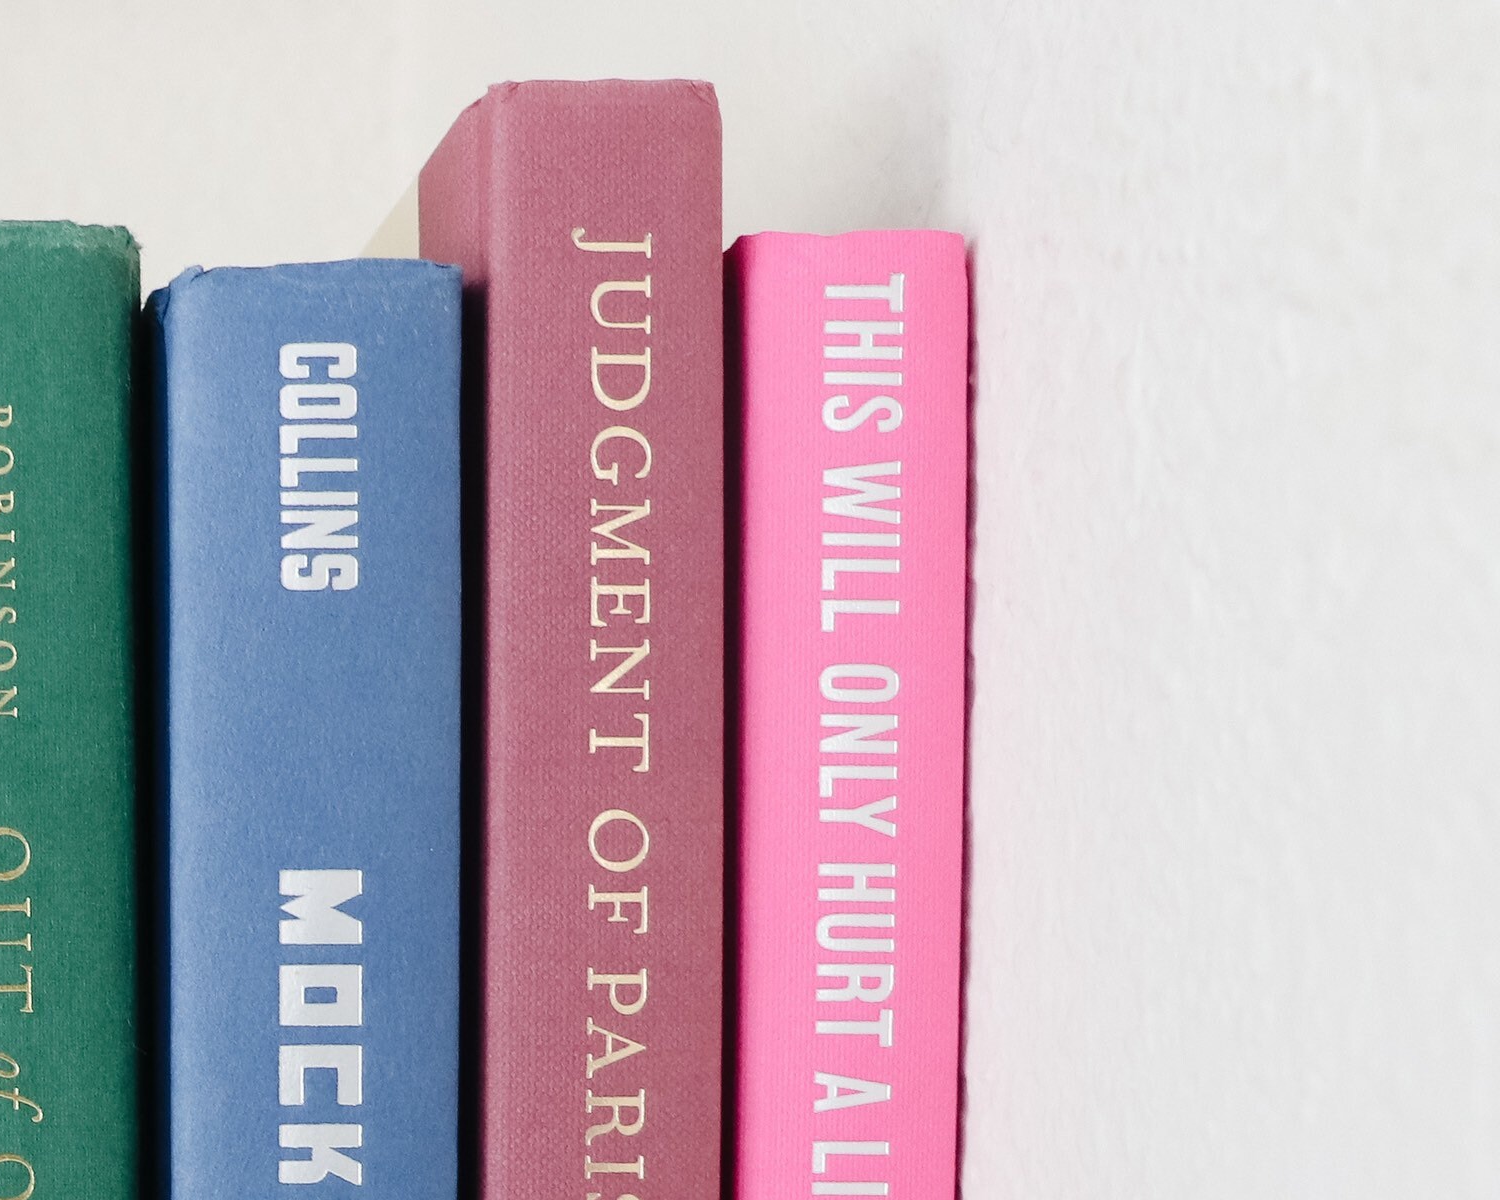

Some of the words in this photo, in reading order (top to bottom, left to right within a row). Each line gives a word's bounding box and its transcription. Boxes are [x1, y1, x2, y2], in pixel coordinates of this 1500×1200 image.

[821, 272, 905, 433] THIS
[278, 341, 359, 592] COLLINS
[571, 226, 652, 774] JUDGMENT
[821, 460, 902, 633] WILL
[818, 663, 900, 837] ONLY
[587, 808, 650, 934] OF
[815, 862, 896, 1047] HURT
[813, 1071, 892, 1114] A
